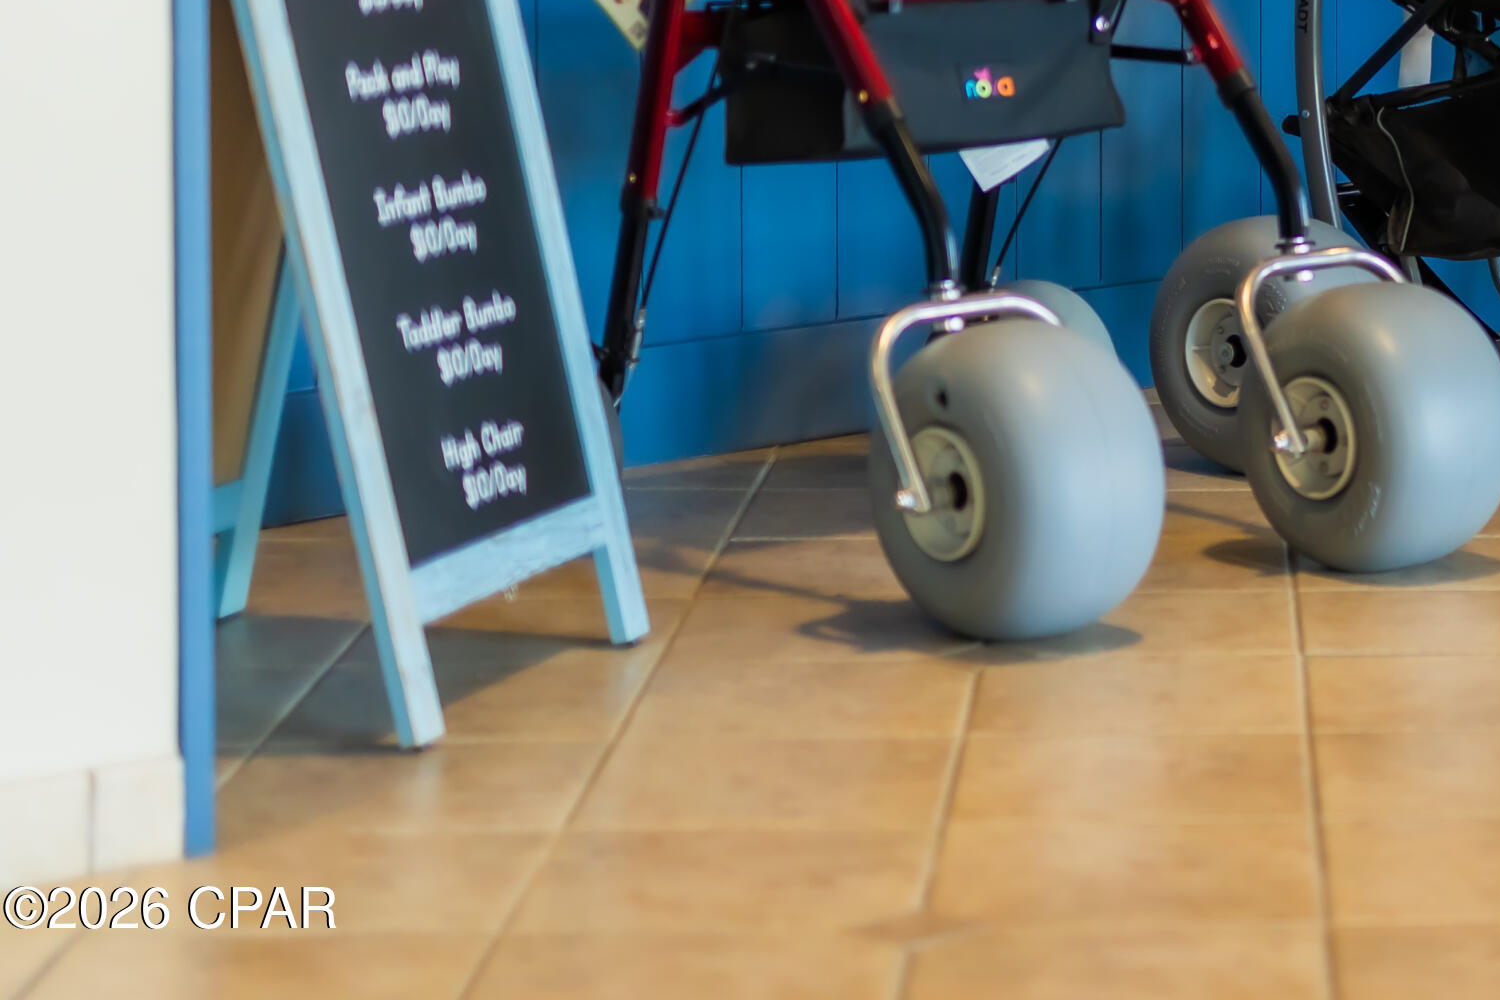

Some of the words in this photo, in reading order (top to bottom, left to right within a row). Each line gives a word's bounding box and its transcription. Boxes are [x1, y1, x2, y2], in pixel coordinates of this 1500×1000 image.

[391, 51, 424, 93] and
[422, 48, 460, 89] Play
[373, 182, 432, 227] Infant
[432, 168, 487, 212] Bumbo
[396, 305, 462, 352] Toddler
[463, 289, 516, 333] Bumbo
[440, 427, 482, 471] High
[480, 419, 524, 456] Chair
